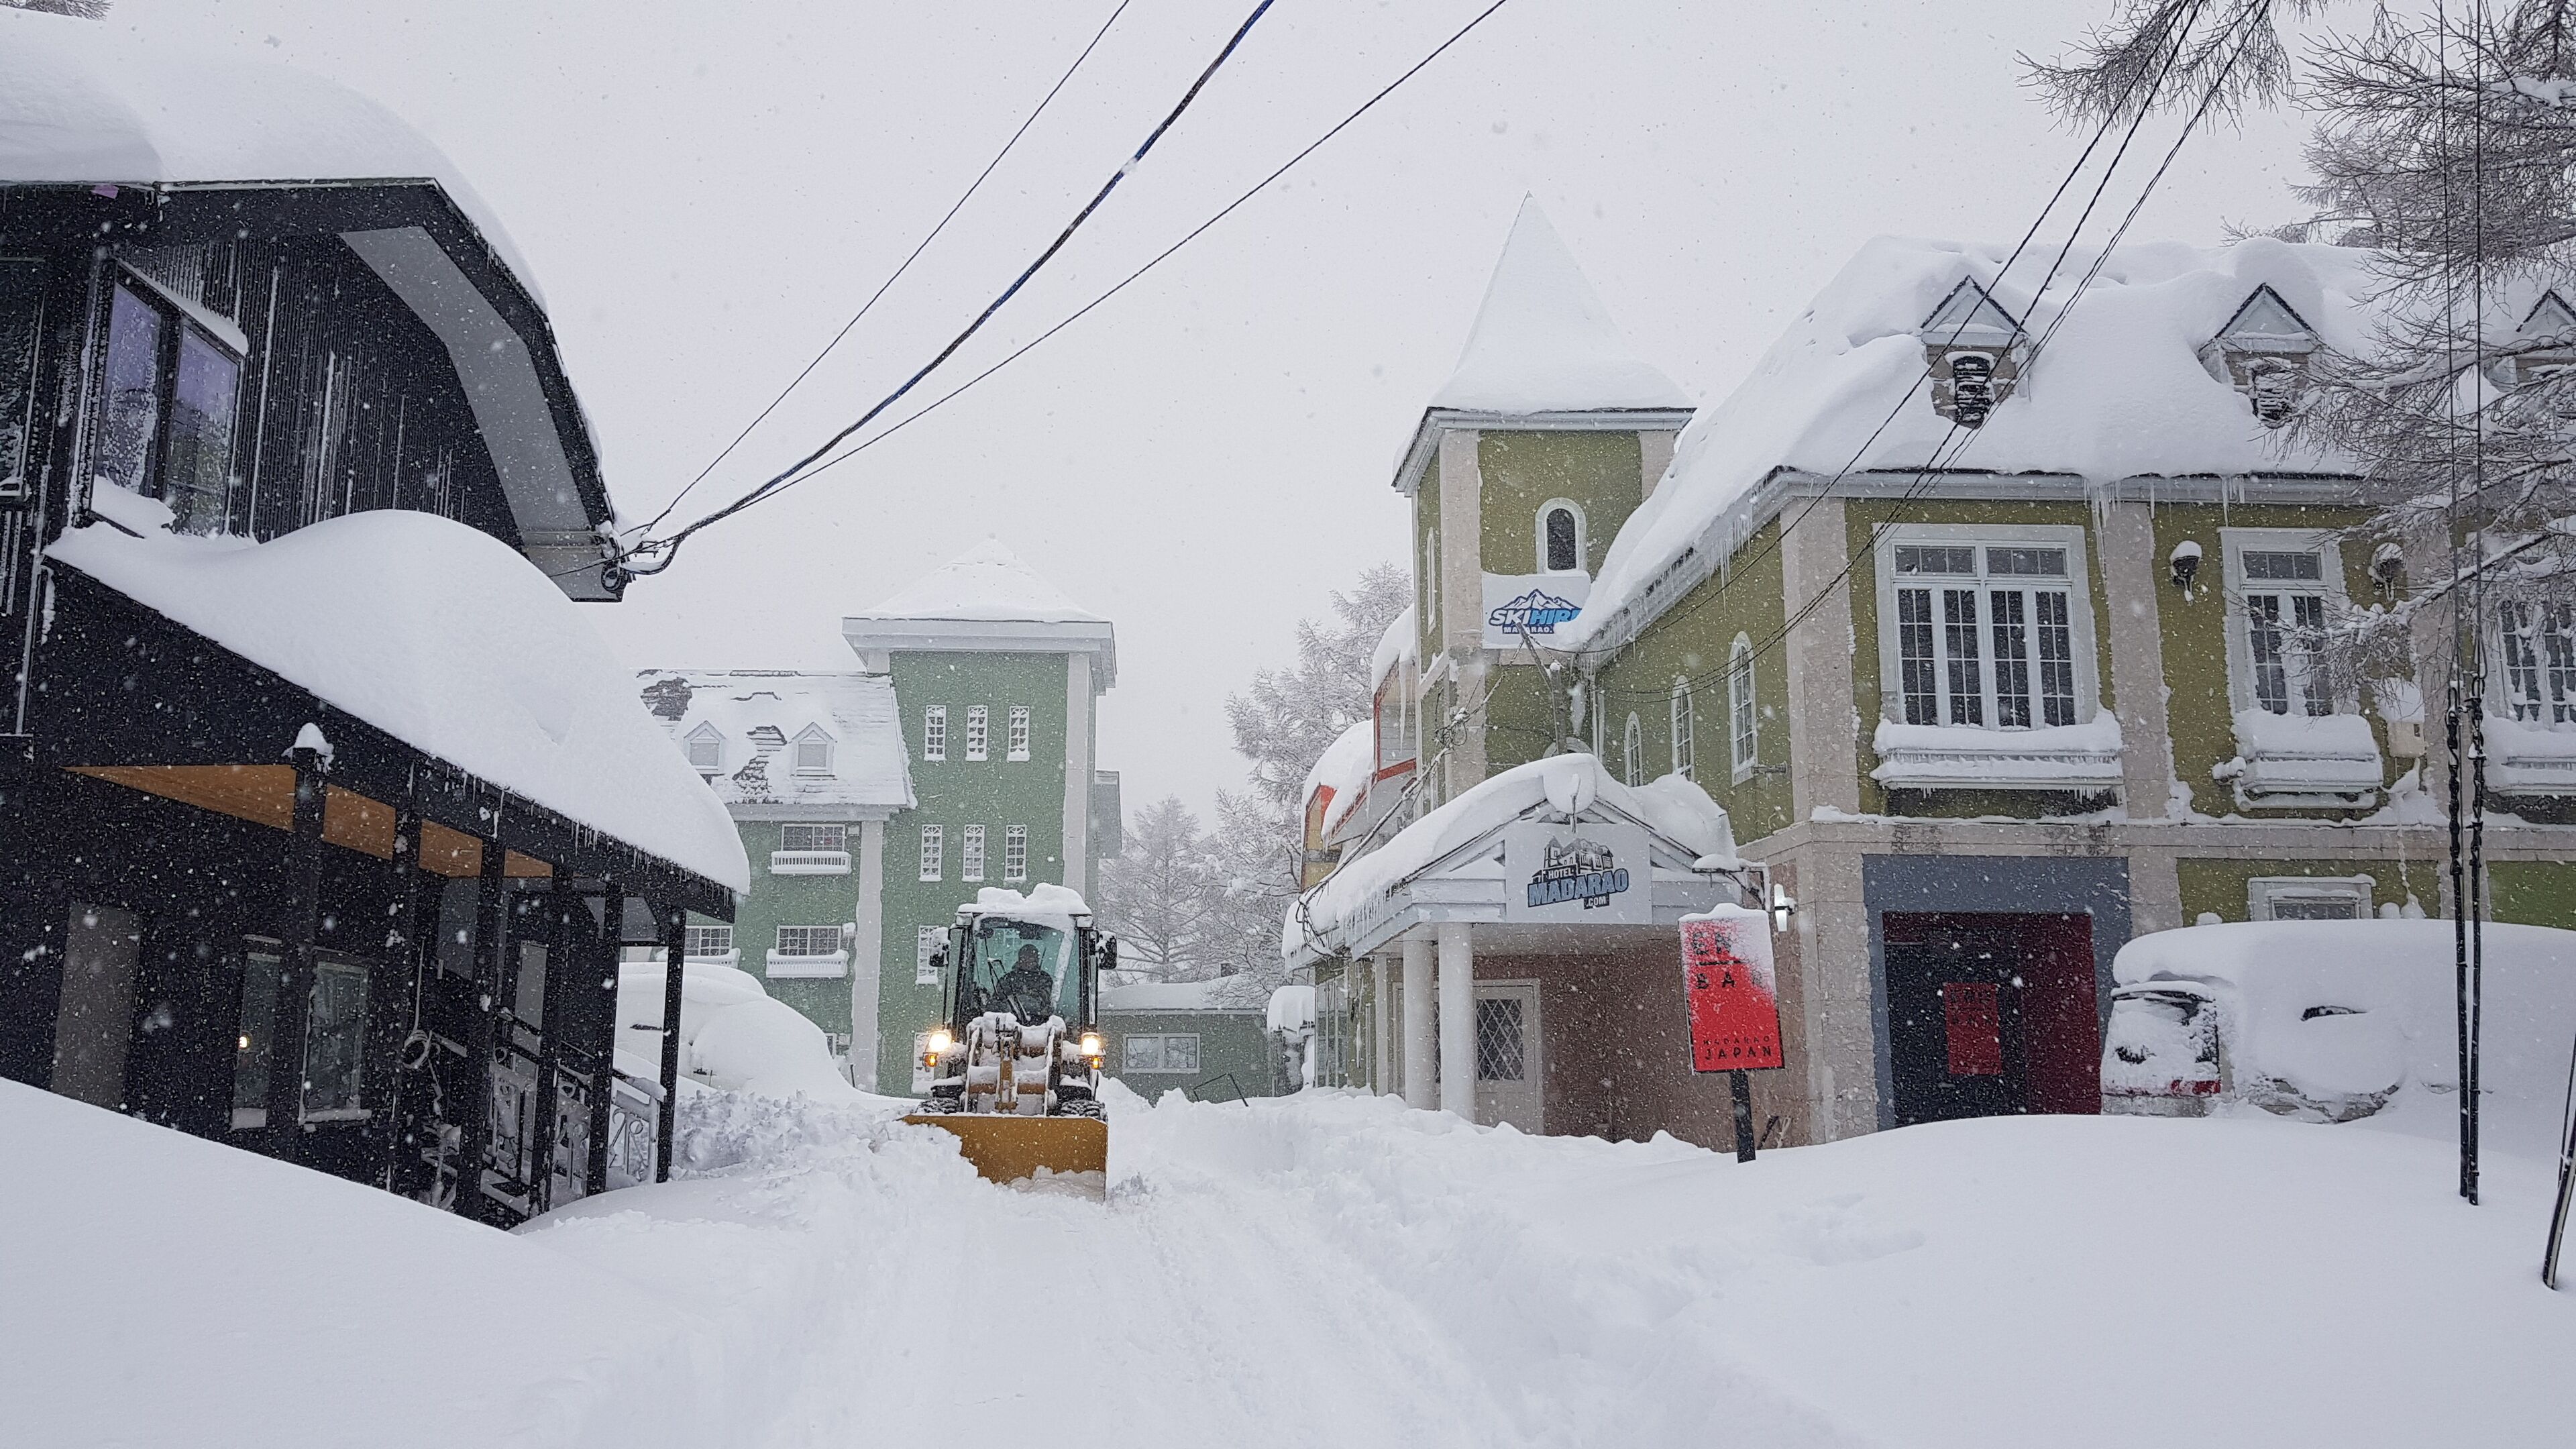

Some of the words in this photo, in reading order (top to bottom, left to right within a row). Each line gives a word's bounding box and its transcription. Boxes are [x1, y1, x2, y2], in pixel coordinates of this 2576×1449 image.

[1548, 868, 1573, 879] HOTEL
[1527, 868, 1629, 907] MADARAO
[1586, 895, 1607, 907] .COM
[1705, 1046, 1771, 1060] JAPAN
